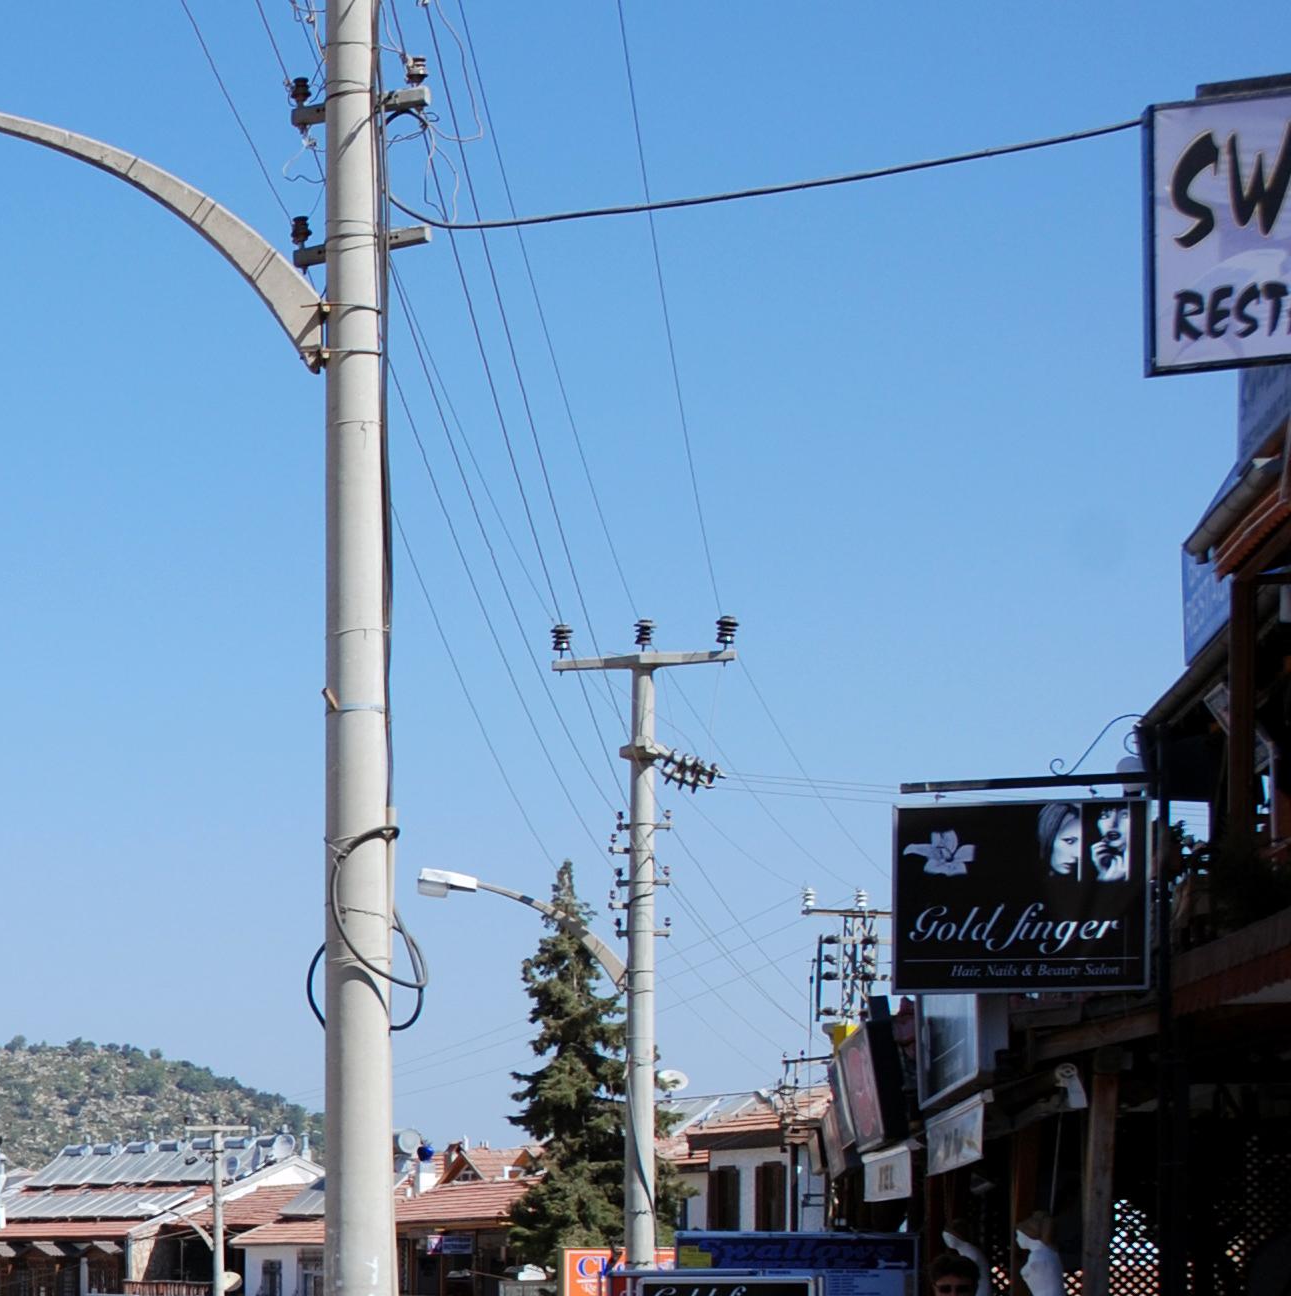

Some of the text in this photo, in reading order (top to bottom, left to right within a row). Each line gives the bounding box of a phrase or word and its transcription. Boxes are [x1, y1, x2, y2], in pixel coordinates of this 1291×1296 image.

[1173, 281, 1291, 343] REST
[909, 902, 1120, 954] Gold finger
[985, 965, 1018, 977] Nails
[1021, 964, 1033, 977] &
[1037, 964, 1080, 980] Beauty
[1083, 963, 1120, 976] Salon
